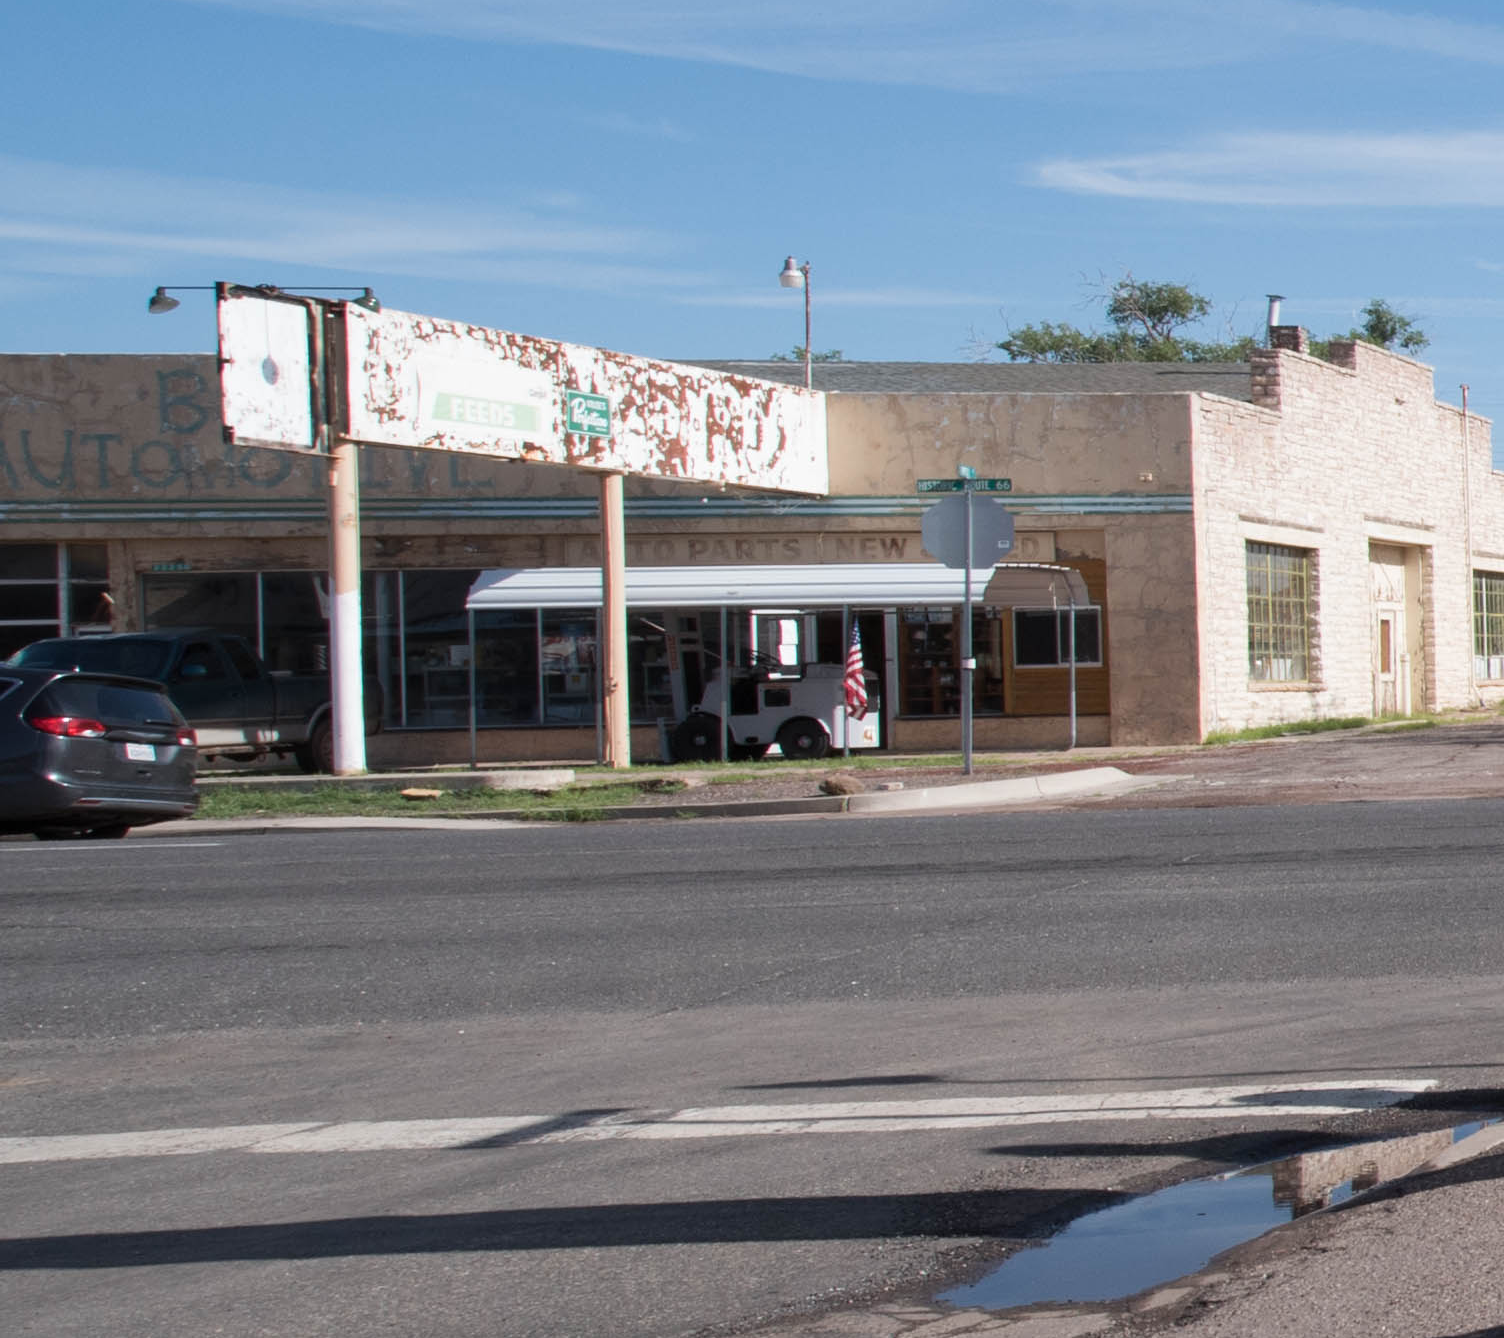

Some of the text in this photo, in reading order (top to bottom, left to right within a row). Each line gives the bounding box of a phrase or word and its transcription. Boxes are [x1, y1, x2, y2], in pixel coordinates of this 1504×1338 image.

[450, 396, 514, 428] FEEDS
[996, 480, 1010, 491] 66
[582, 538, 800, 560] ATO PARTS
[835, 537, 907, 560] NEW
